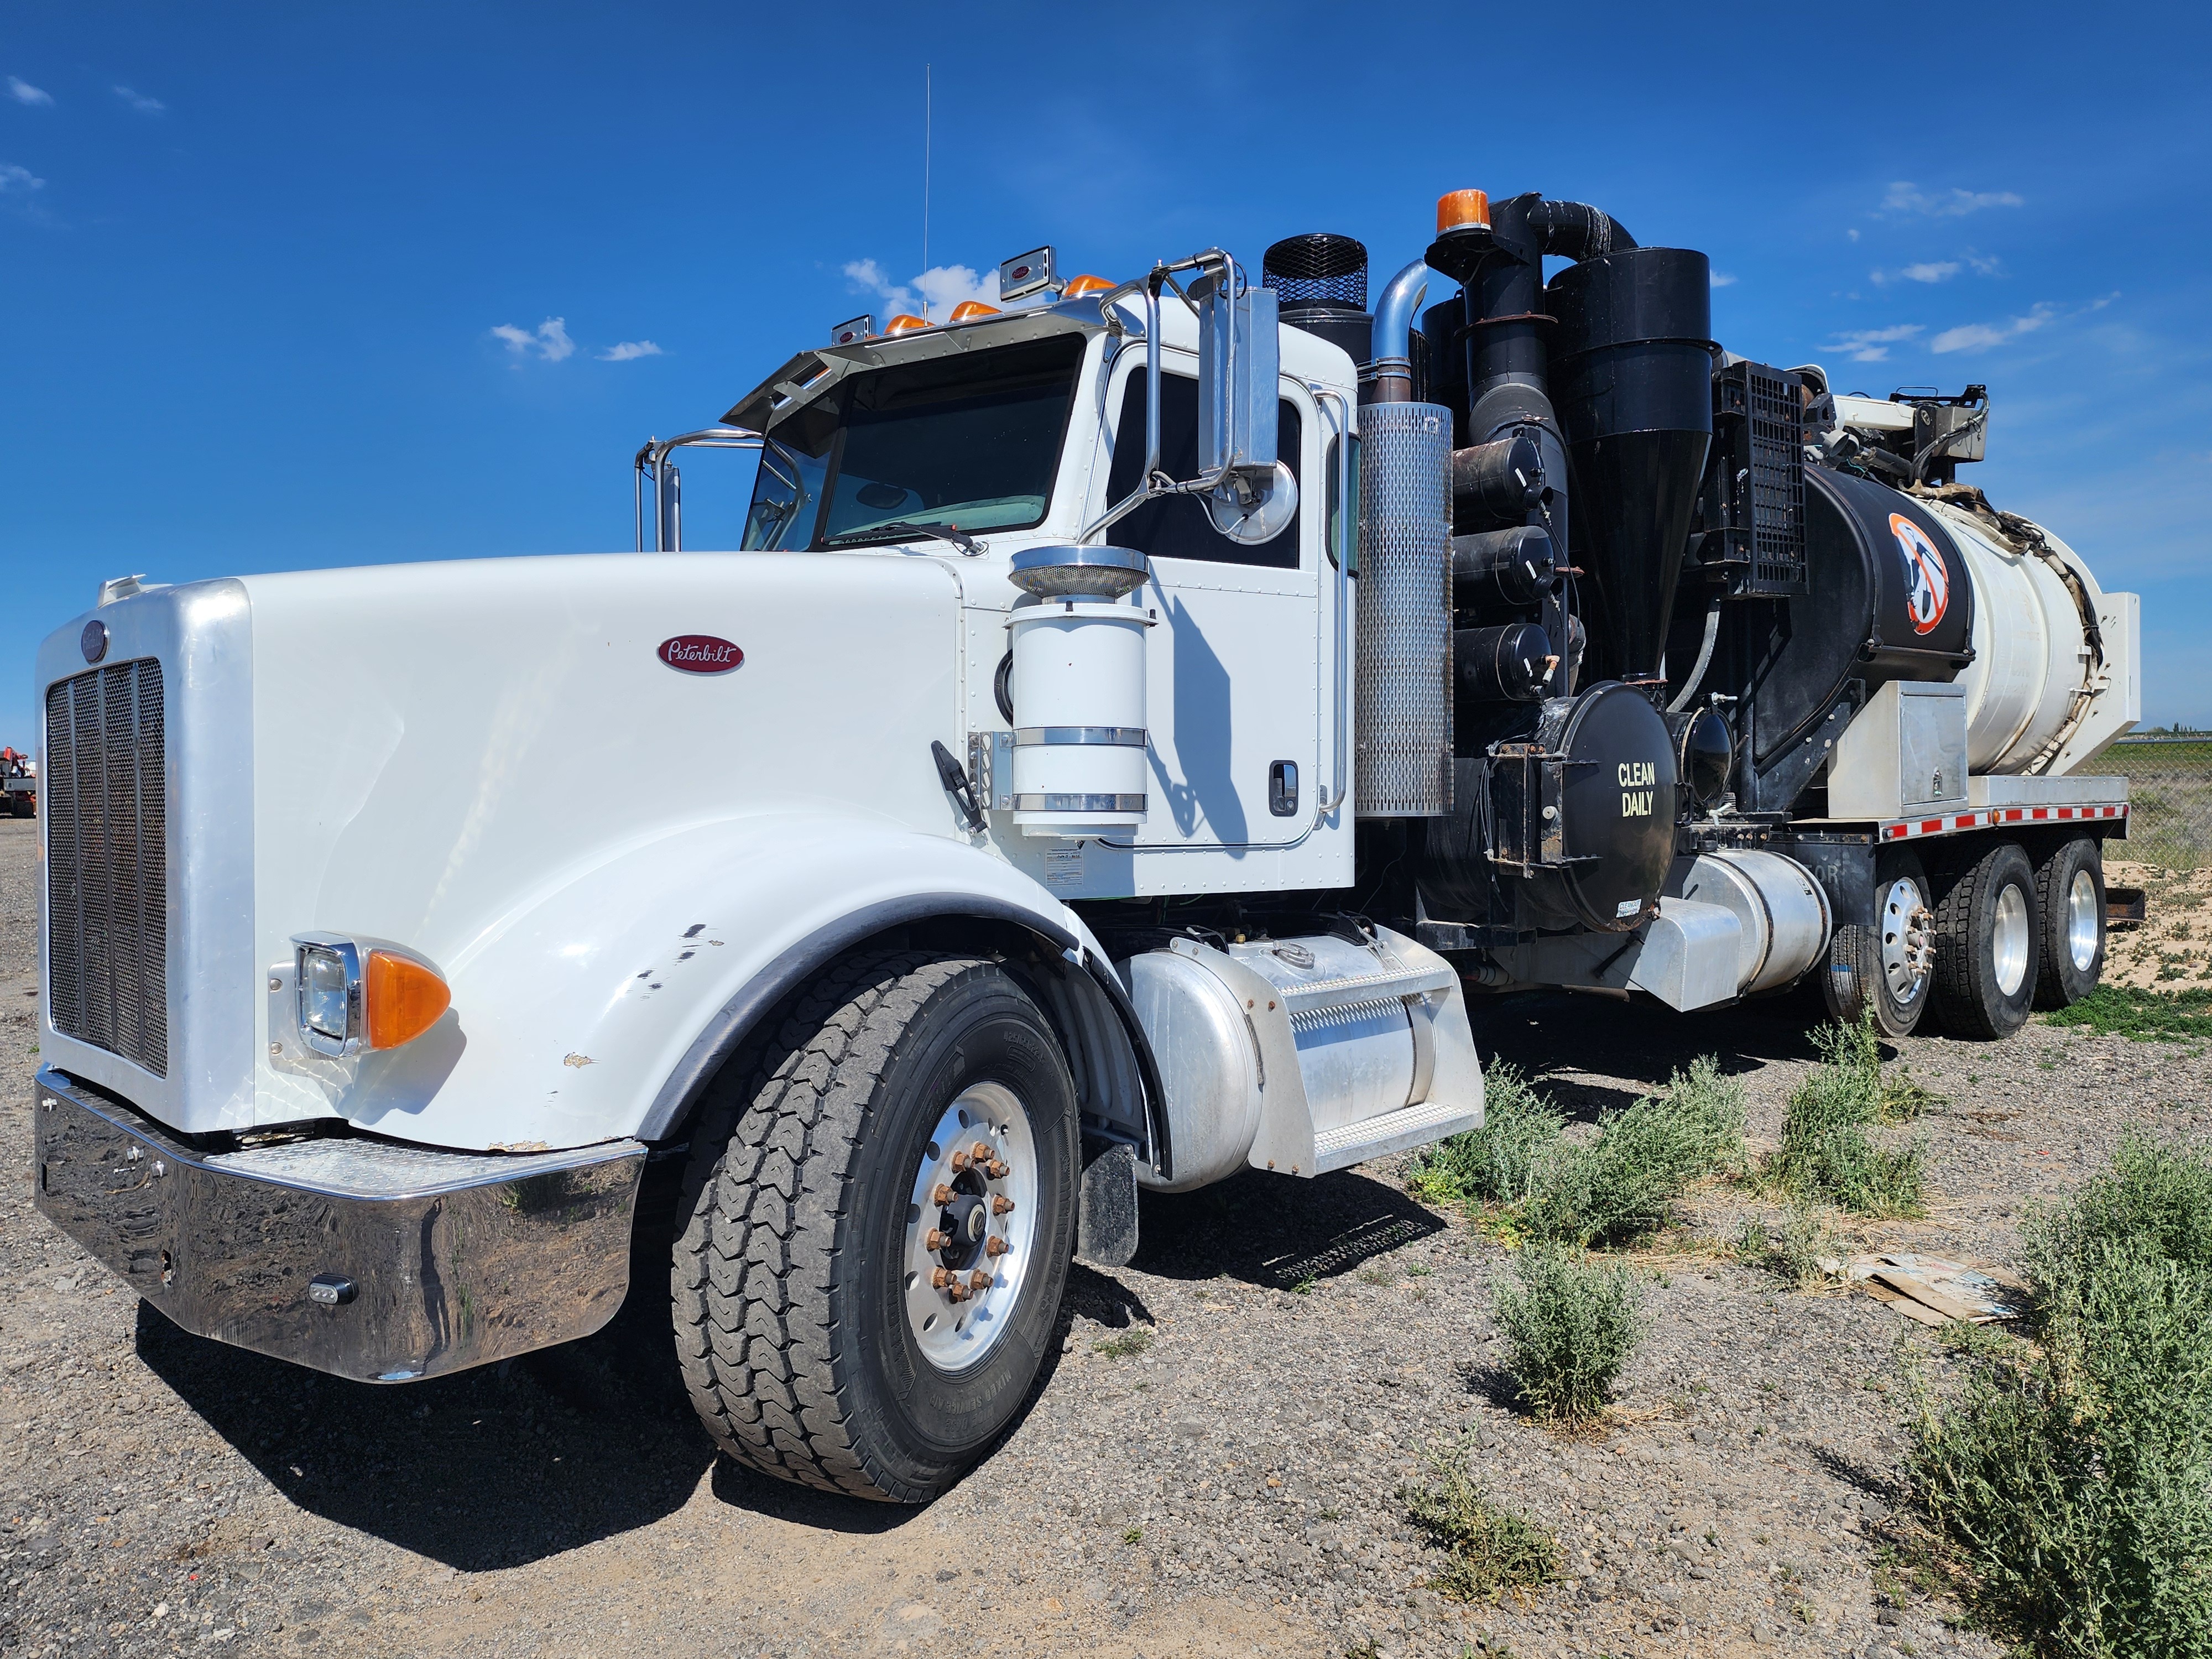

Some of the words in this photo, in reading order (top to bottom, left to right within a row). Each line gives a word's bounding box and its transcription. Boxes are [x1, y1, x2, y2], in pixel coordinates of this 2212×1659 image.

[668, 640, 737, 662] Peterbilt
[1618, 762, 1655, 787] CLEAN
[1622, 790, 1653, 817] DAILY
[985, 1369, 1012, 1402] MIXED
[946, 1394, 983, 1415] SERVICE
